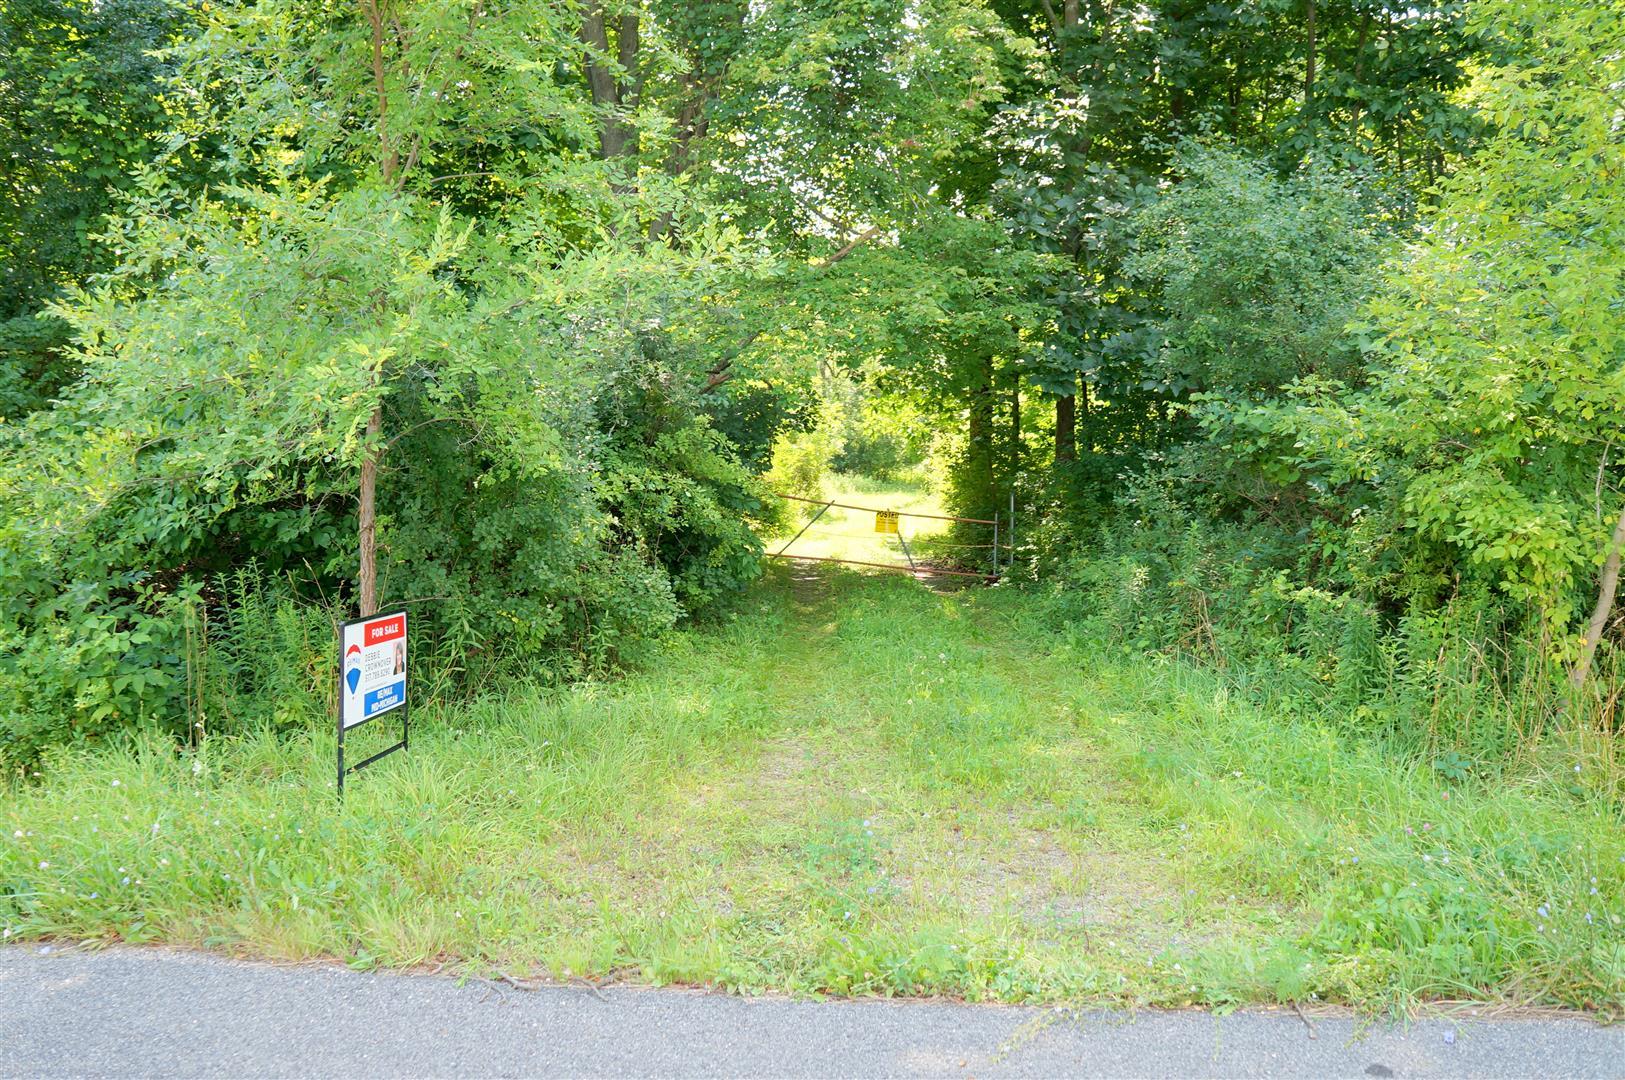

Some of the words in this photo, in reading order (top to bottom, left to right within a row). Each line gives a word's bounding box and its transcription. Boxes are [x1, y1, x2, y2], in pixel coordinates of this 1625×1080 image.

[372, 626, 384, 639] FOR
[384, 623, 399, 636] SALE
[365, 650, 380, 662] DEBBIE
[377, 687, 393, 700] RE/MAX
